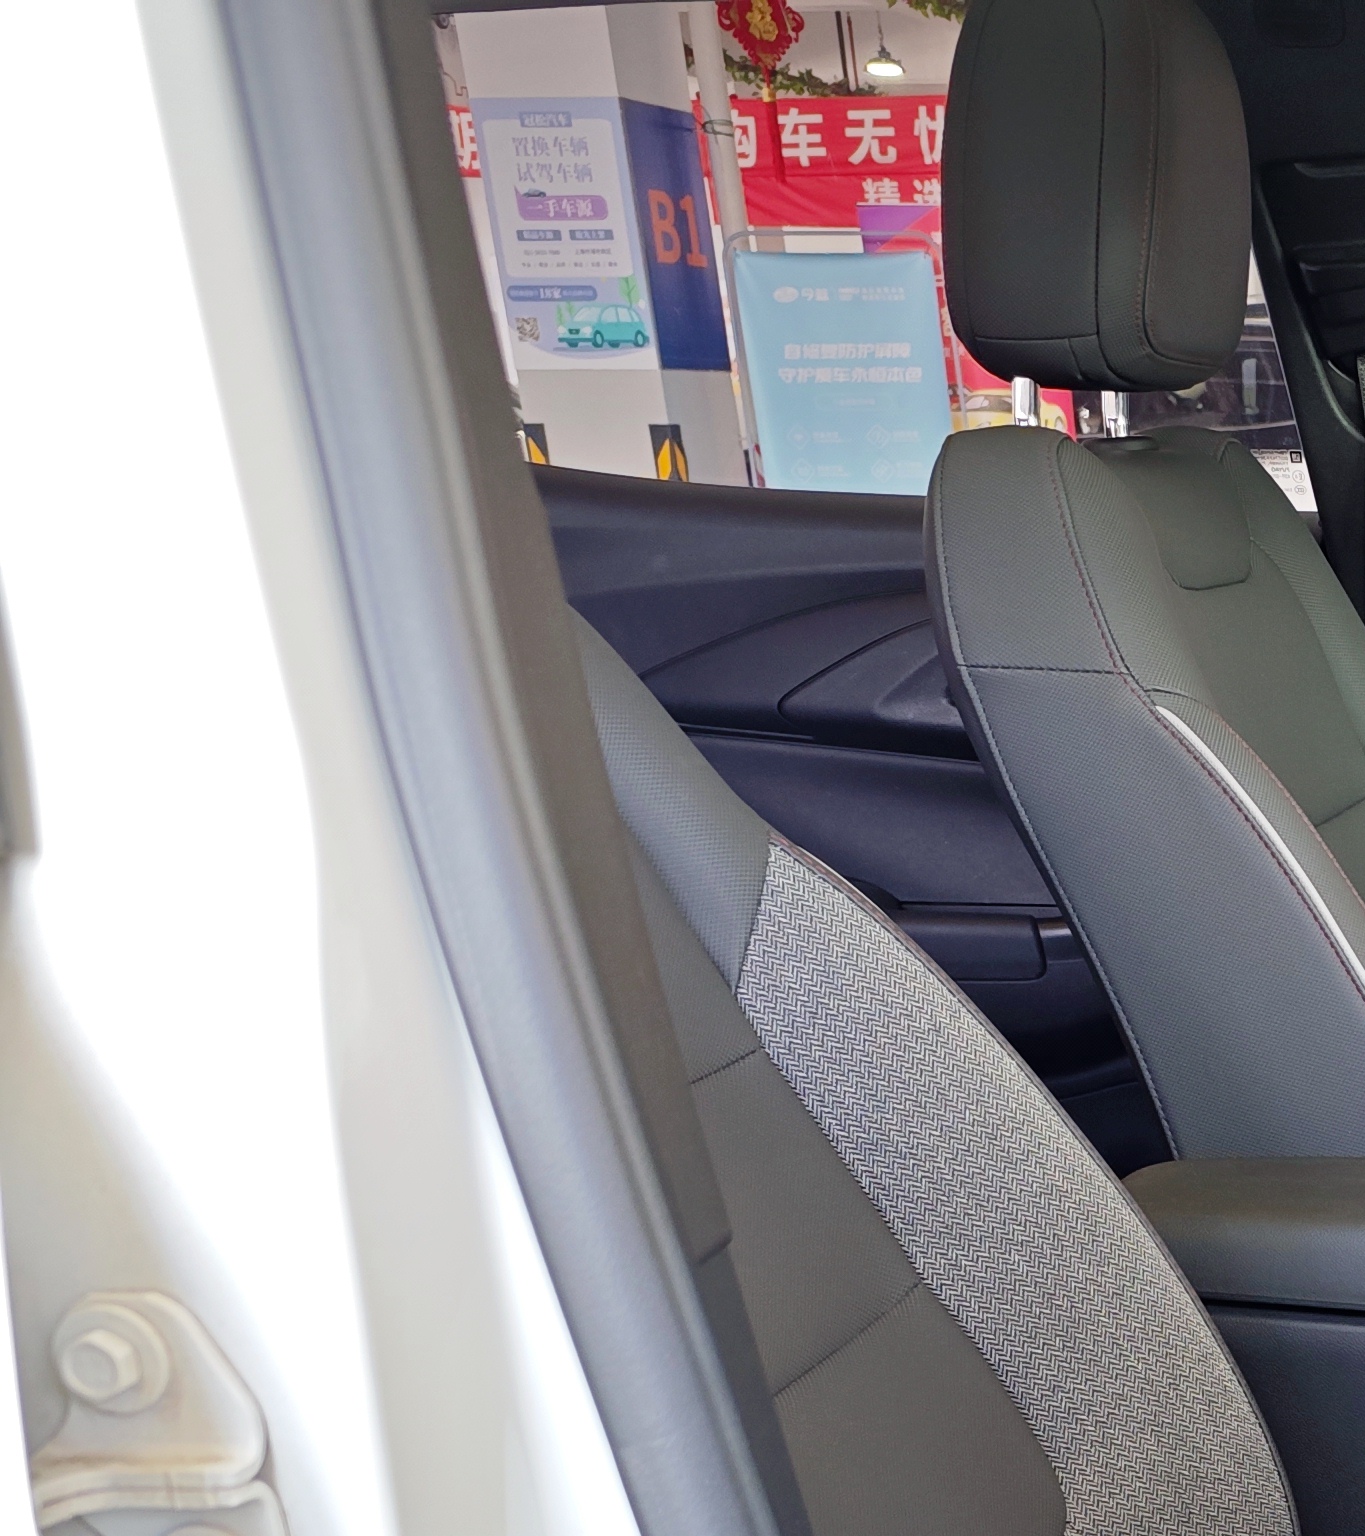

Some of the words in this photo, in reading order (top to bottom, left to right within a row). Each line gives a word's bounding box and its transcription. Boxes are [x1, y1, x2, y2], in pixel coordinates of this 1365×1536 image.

[511, 136, 589, 157] 置换车辆
[516, 162, 593, 184] 试驾车辆
[526, 199, 594, 218] 一手车源
[648, 189, 708, 268] B1
